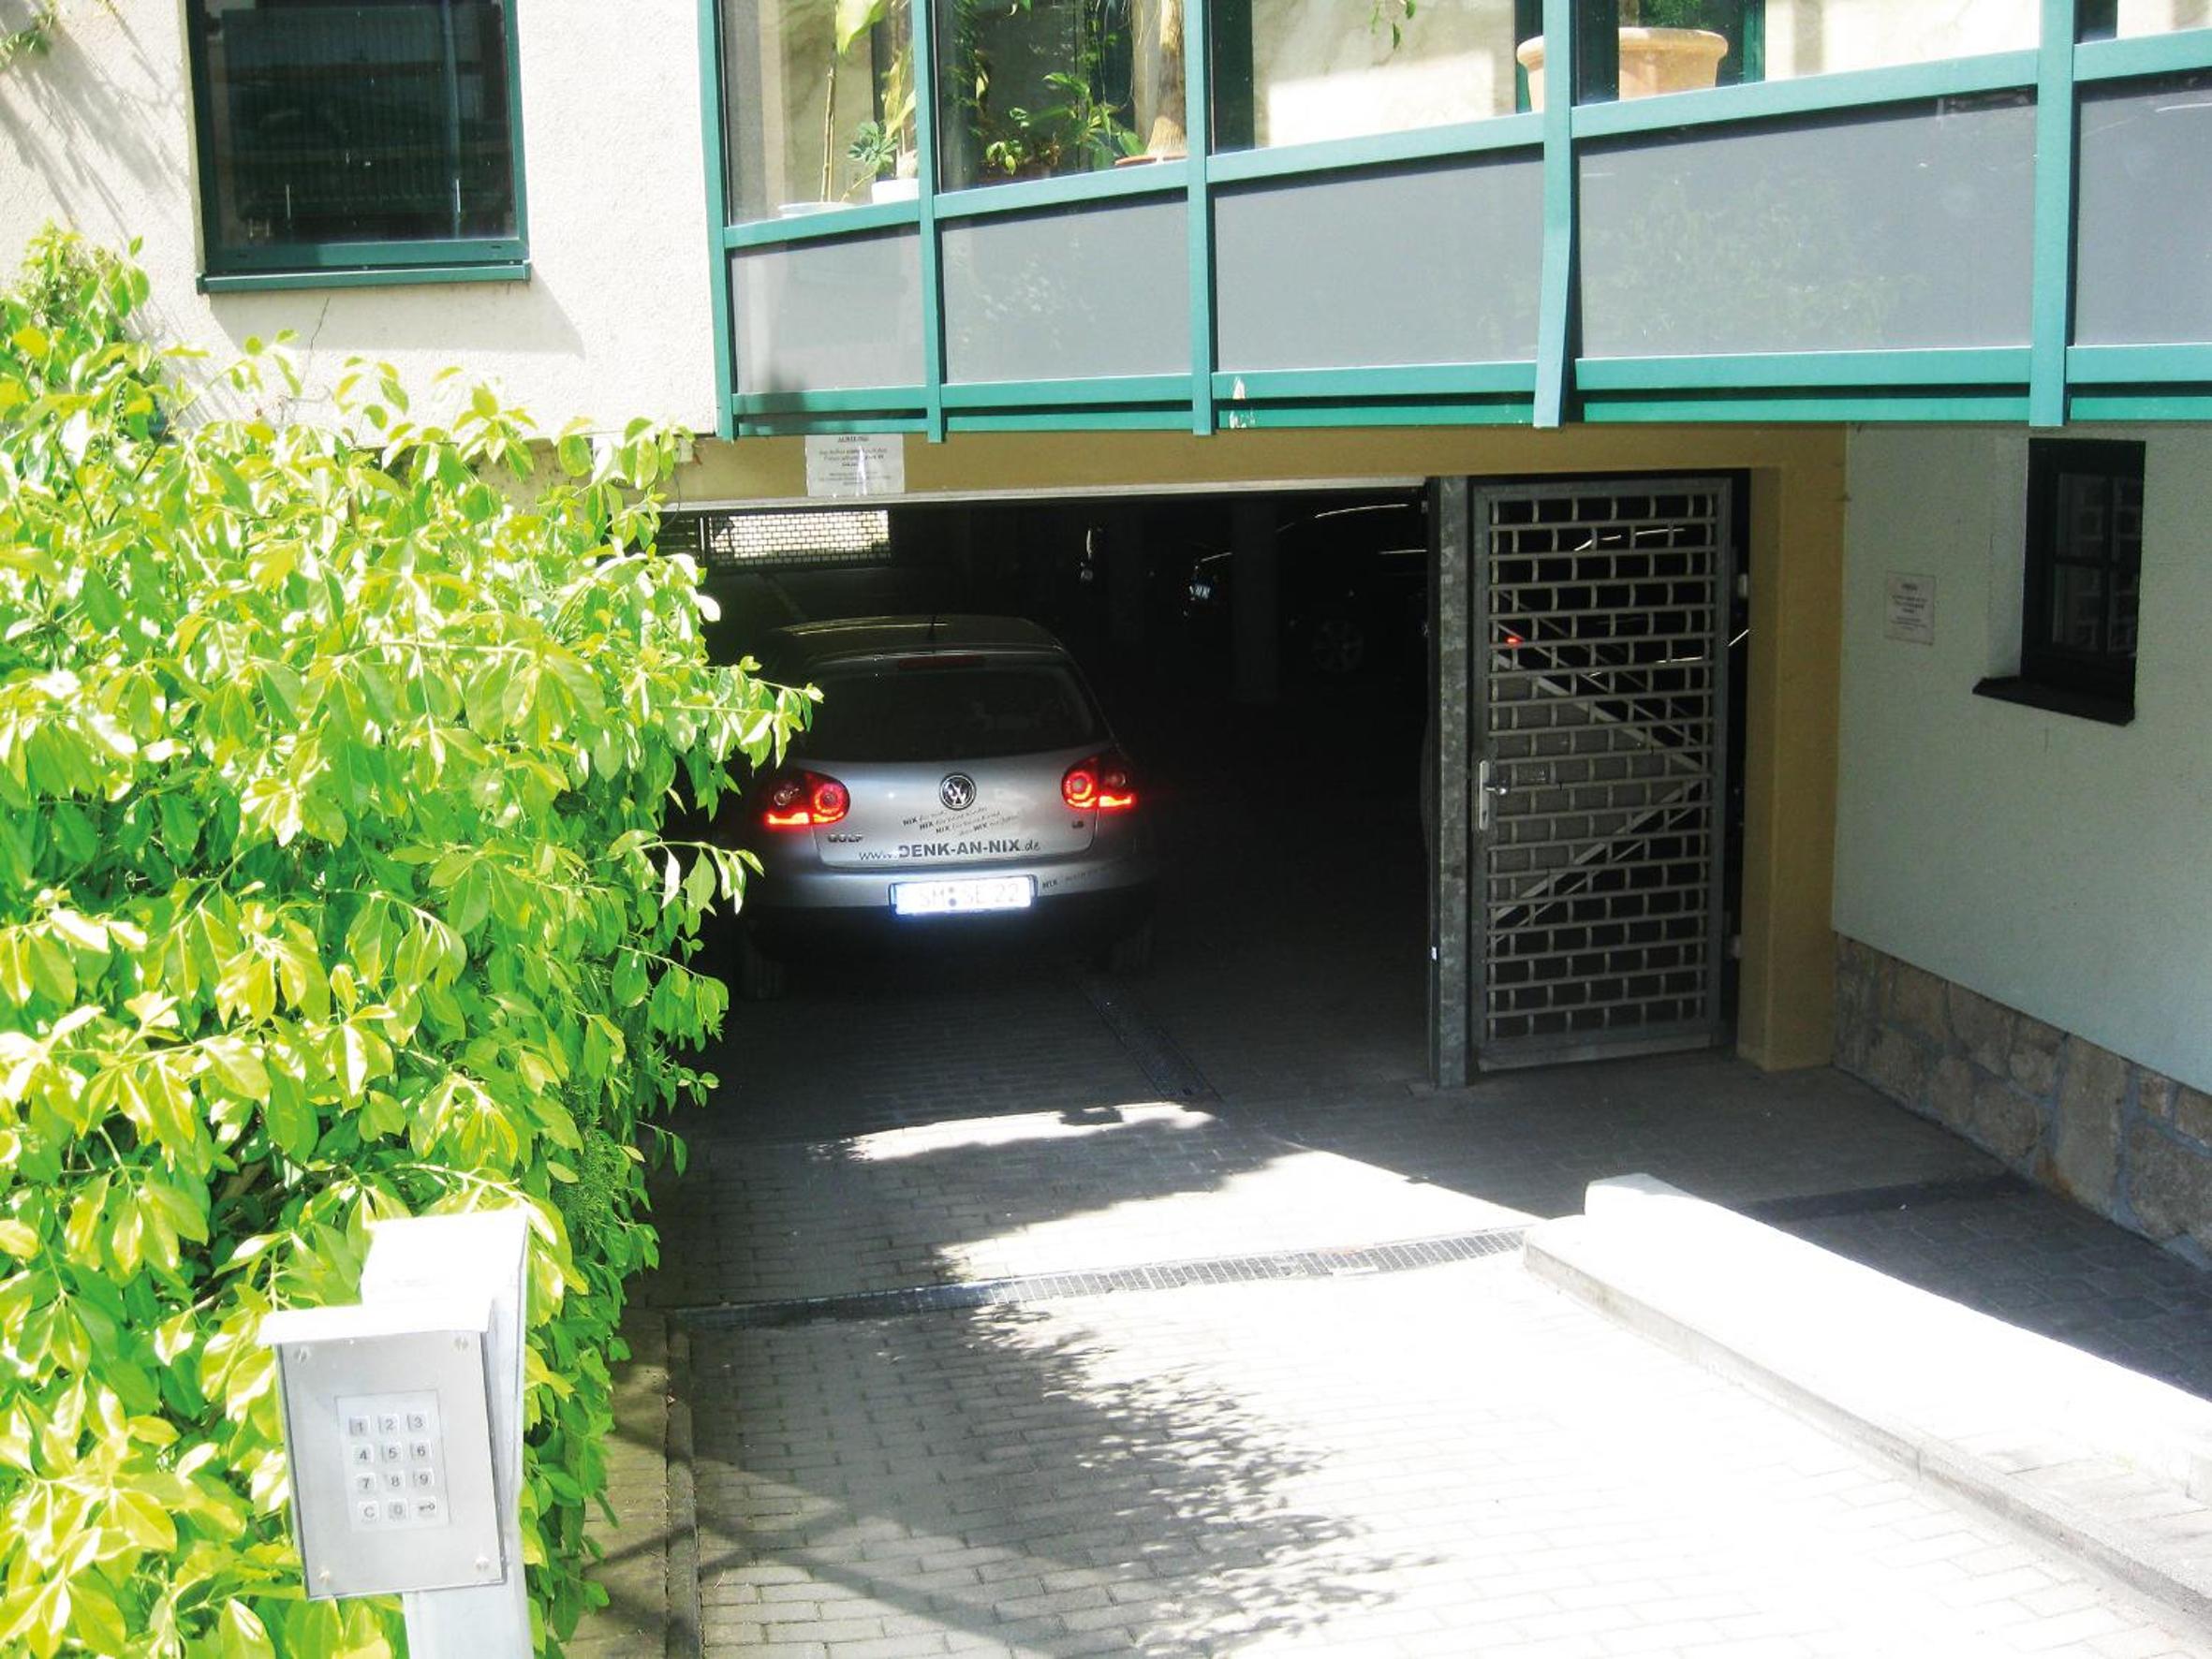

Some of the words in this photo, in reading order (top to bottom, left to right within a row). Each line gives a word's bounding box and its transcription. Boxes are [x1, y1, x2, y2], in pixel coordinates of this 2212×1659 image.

[356, 1421, 364, 1433] 1
[385, 1418, 395, 1431] 2
[413, 1417, 423, 1429] 3
[359, 1449, 368, 1461] 4
[388, 1447, 398, 1460] 5
[417, 1446, 426, 1457] 6
[361, 1477, 371, 1490] 7
[391, 1475, 401, 1488] 8
[420, 1474, 429, 1486] 9
[363, 1506, 376, 1519] C
